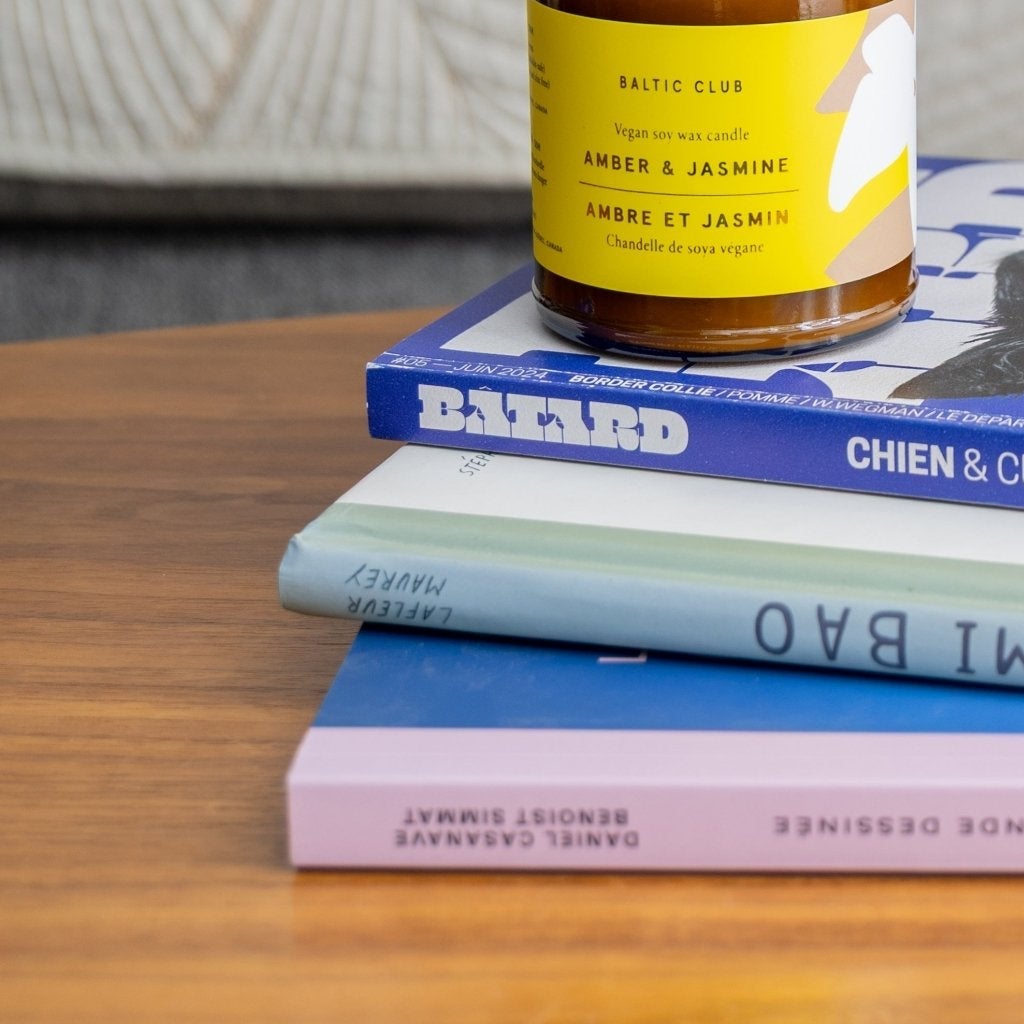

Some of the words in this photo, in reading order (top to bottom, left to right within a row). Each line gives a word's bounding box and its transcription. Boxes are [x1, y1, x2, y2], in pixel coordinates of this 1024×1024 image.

[620, 76, 682, 93] BALTIC
[695, 80, 742, 93] CLUB
[614, 123, 648, 142] Vegan
[653, 129, 673, 144] soy
[678, 131, 702, 141] wax
[707, 128, 750, 142] candle
[584, 150, 649, 174] AMBER
[662, 160, 674, 175] &
[687, 158, 789, 177] JASMINE
[586, 202, 652, 225] AMBRE
[664, 212, 690, 227] ET
[702, 209, 789, 228] JASMIN
[606, 234, 664, 253] Chandelle
[668, 240, 683, 253] de
[688, 244, 715, 258] soya
[453, 362, 498, 374] JUIN
[502, 367, 548, 380] 2024
[569, 374, 648, 390] BORDER
[649, 381, 716, 397] COLLIE
[726, 389, 799, 405] POMME
[936, 410, 963, 422] LE
[417, 384, 689, 456] BÂTARD
[459, 451, 496, 477] STÉP
[846, 436, 955, 478] CHIEN
[963, 448, 988, 482] &
[345, 563, 448, 596] MAUREY
[348, 596, 453, 625] LAFLEUR
[755, 602, 908, 670] BAO
[404, 807, 506, 825] SIMMAT
[517, 808, 630, 826] BENOIST
[773, 815, 941, 837] DESSINÉE
[395, 829, 535, 848] CASANAVE
[547, 831, 639, 848] DANIEL
